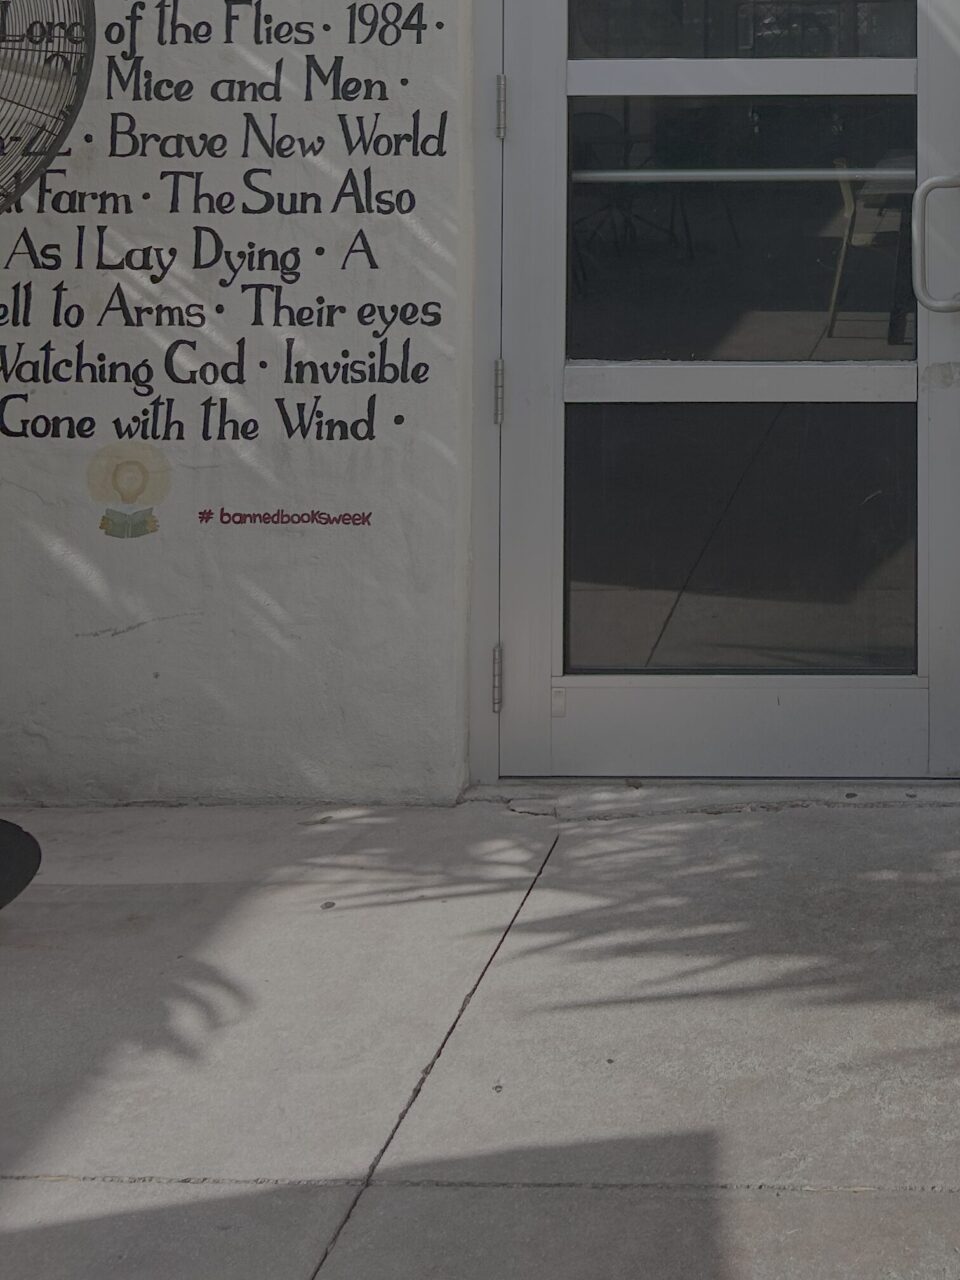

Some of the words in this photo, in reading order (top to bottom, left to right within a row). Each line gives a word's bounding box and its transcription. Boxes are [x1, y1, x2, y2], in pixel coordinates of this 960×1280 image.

[105, 2, 145, 60] of
[346, 2, 427, 46] 1984
[106, 55, 193, 101] Mice
[210, 57, 283, 102] and
[304, 54, 389, 101] Men
[108, 112, 227, 158] Brave
[241, 112, 325, 158] New
[337, 109, 448, 157] World
[38, 169, 132, 213] Farm
[160, 171, 235, 214] The
[242, 168, 322, 215] Sun
[330, 166, 416, 215] Also
[3, 227, 61, 270] As
[75, 225, 85, 269] I
[96, 225, 177, 284] Lay
[192, 226, 300, 288] Dying
[341, 229, 379, 270] A
[52, 280, 84, 328] to
[97, 282, 205, 328] Arms
[241, 284, 346, 327] Their
[357, 302, 441, 338] eyes
[164, 337, 246, 385] God
[284, 337, 429, 384] Invisible
[0, 393, 95, 439] Gone
[112, 394, 185, 440] with
[200, 396, 259, 441] the
[274, 394, 376, 441] Wind
